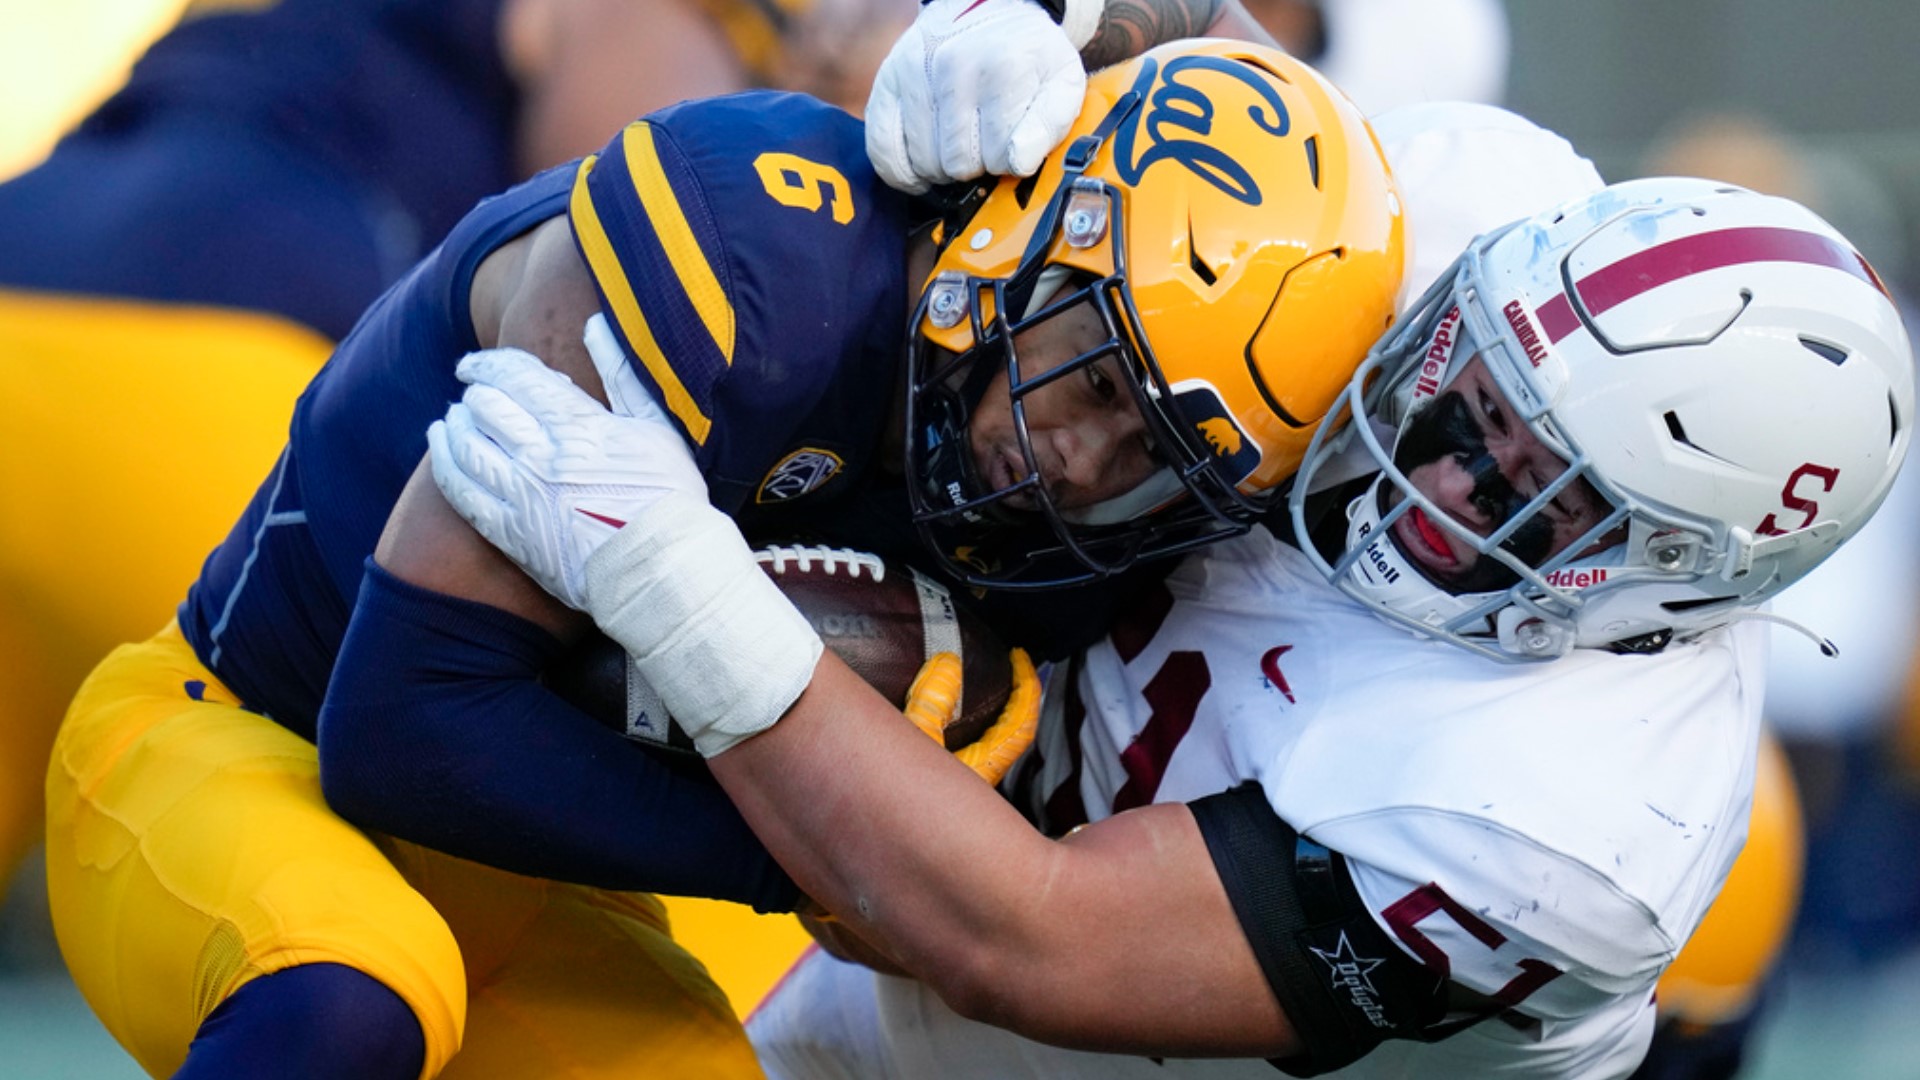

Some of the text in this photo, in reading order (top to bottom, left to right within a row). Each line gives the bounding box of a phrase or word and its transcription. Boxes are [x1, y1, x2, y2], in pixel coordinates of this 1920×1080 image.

[1113, 56, 1291, 207] Cal
[752, 152, 855, 225] 6
[1502, 299, 1548, 368] CARDINAL
[1754, 463, 1840, 537] S
[1336, 961, 1391, 1029] Douglas
